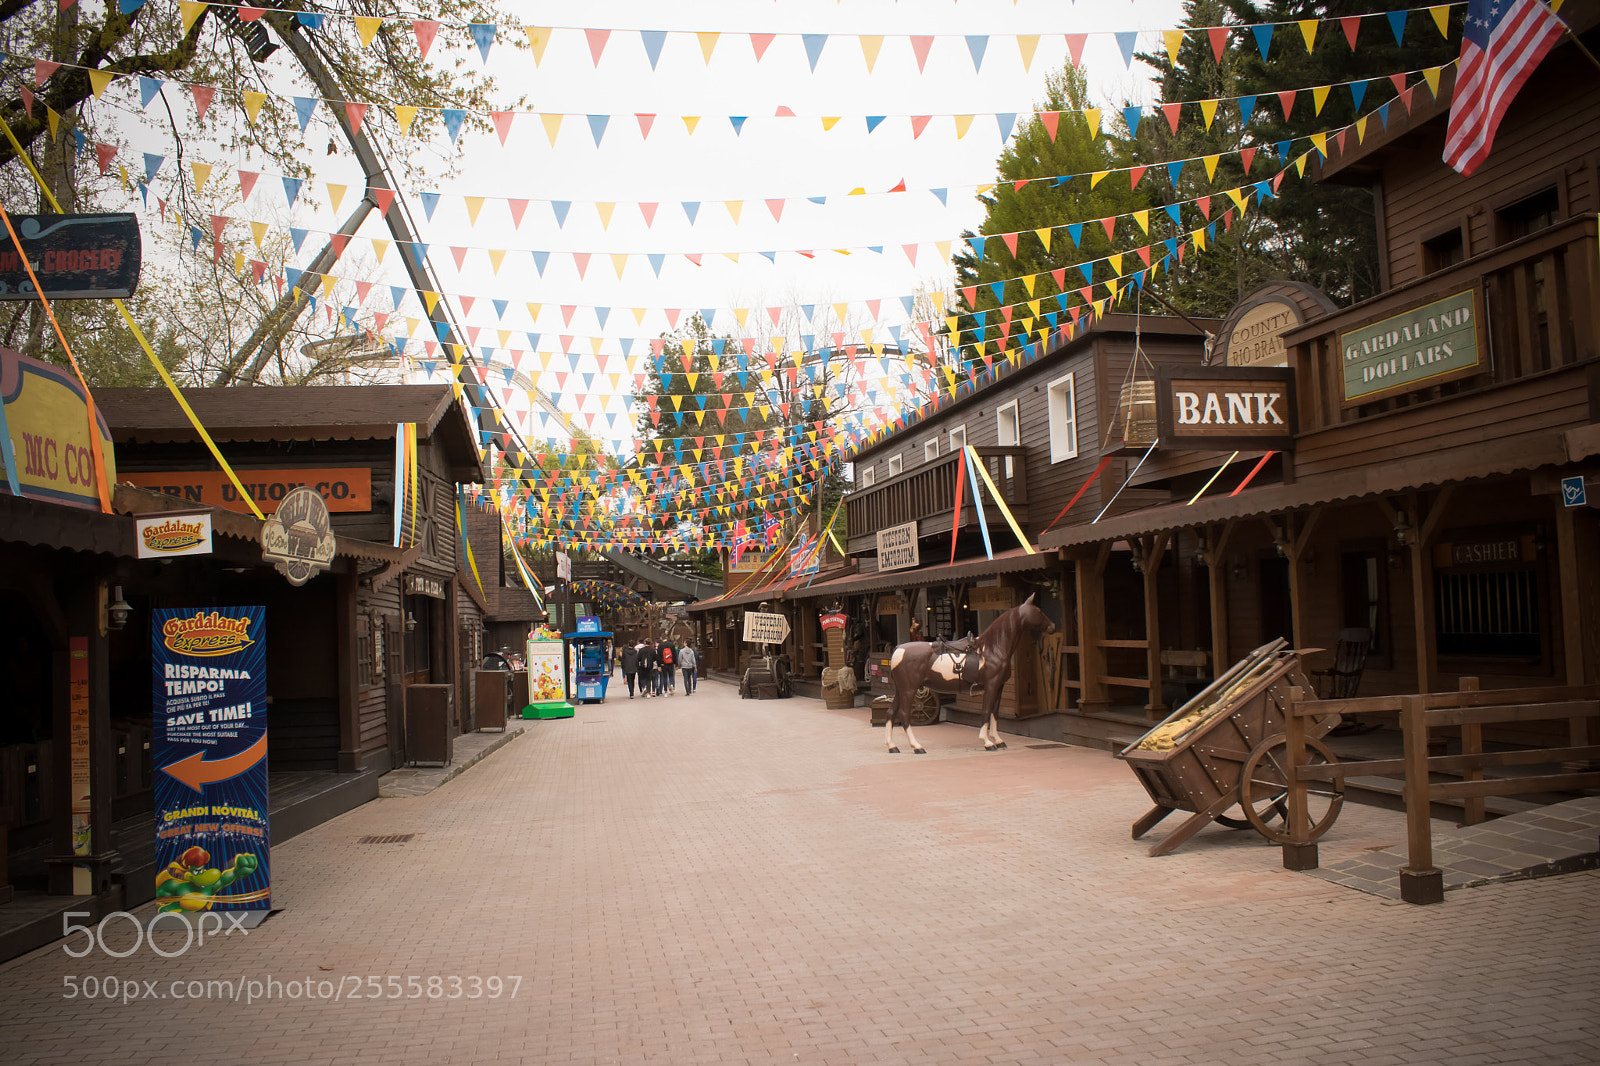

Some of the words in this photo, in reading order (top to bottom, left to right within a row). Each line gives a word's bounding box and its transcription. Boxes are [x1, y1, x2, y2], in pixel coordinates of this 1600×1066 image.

[1231, 310, 1290, 345] COUNTY
[1345, 306, 1470, 362] GARDALAND
[1233, 346, 1251, 367] RIO
[1362, 341, 1454, 384] DOLLARS
[1175, 391, 1284, 426] BANK
[64, 442, 105, 488] CO
[315, 481, 357, 500] CO.
[143, 519, 201, 538] Gardaland
[882, 526, 911, 549] WESTERN
[881, 546, 915, 569] EMPORIUM
[1455, 541, 1518, 563] CASHIER
[163, 611, 250, 637] Gardaland
[164, 663, 251, 680] RISPARMIA
[164, 679, 225, 697] TEMPO!
[190, 694, 208, 703] SUBITO
[166, 706, 177, 714] CHE
[166, 711, 205, 727] SAVE
[209, 702, 253, 722] TIME!
[217, 731, 239, 739] SUITABLE
[163, 805, 209, 822] GRANDI
[211, 805, 259, 820] NOVITÀ!
[159, 824, 193, 839] GREAT
[194, 823, 221, 833] NEW
[222, 823, 264, 838] OFFERS!
